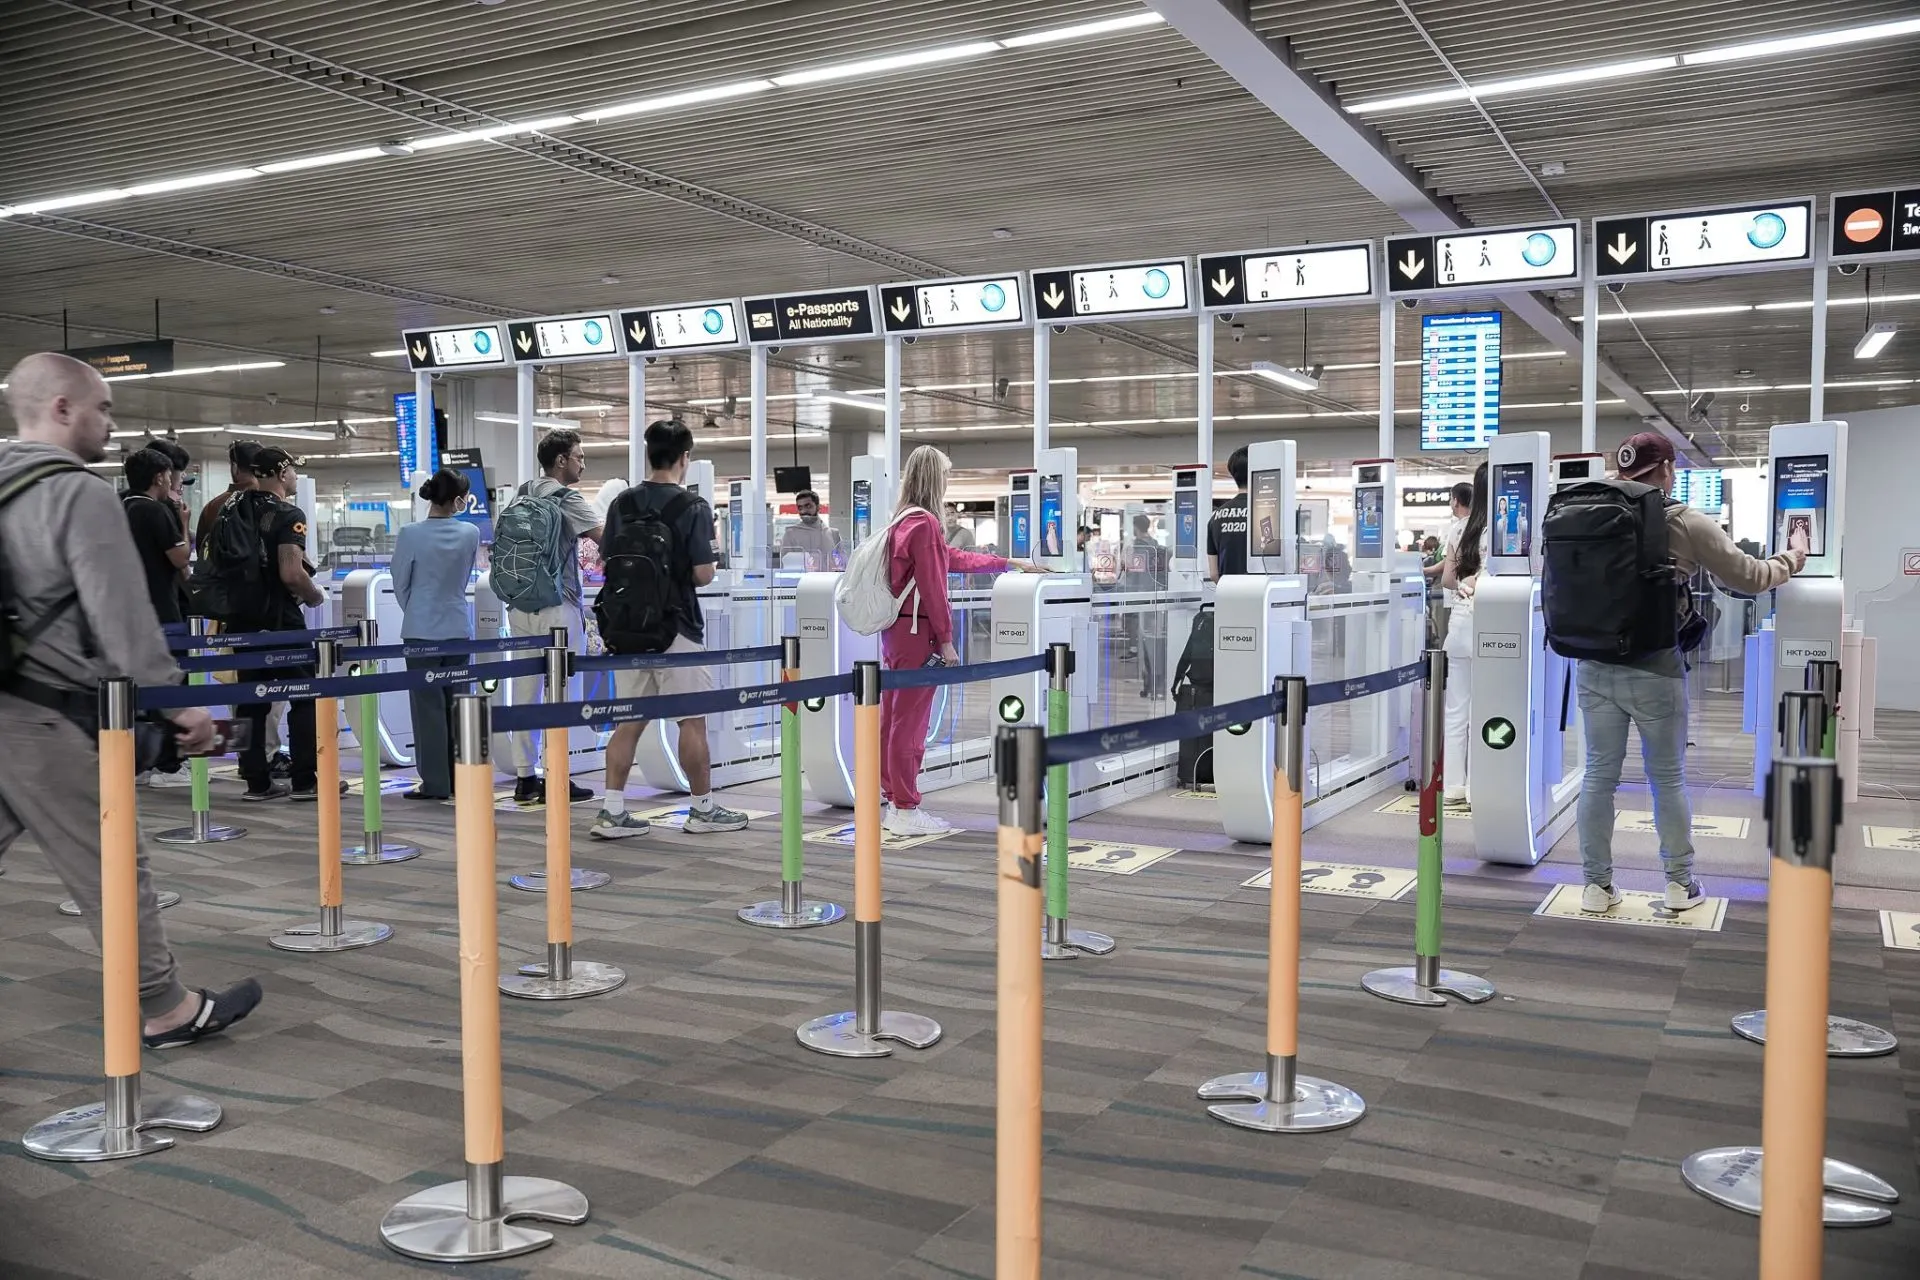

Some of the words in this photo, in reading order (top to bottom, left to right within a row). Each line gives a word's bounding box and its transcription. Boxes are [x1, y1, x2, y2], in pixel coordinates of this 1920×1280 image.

[1903, 222, 1920, 236] ปิด
[786, 300, 860, 316] e-Passports
[789, 319, 801, 330] All
[803, 316, 852, 329] Nationality
[1213, 507, 1248, 520] NGAM
[1221, 522, 1246, 532] 2020
[612, 704, 632, 712] PHUKET
[1331, 888, 1378, 896] HERE
[1563, 911, 1631, 921] STAND
[1638, 918, 1693, 926] HERE
